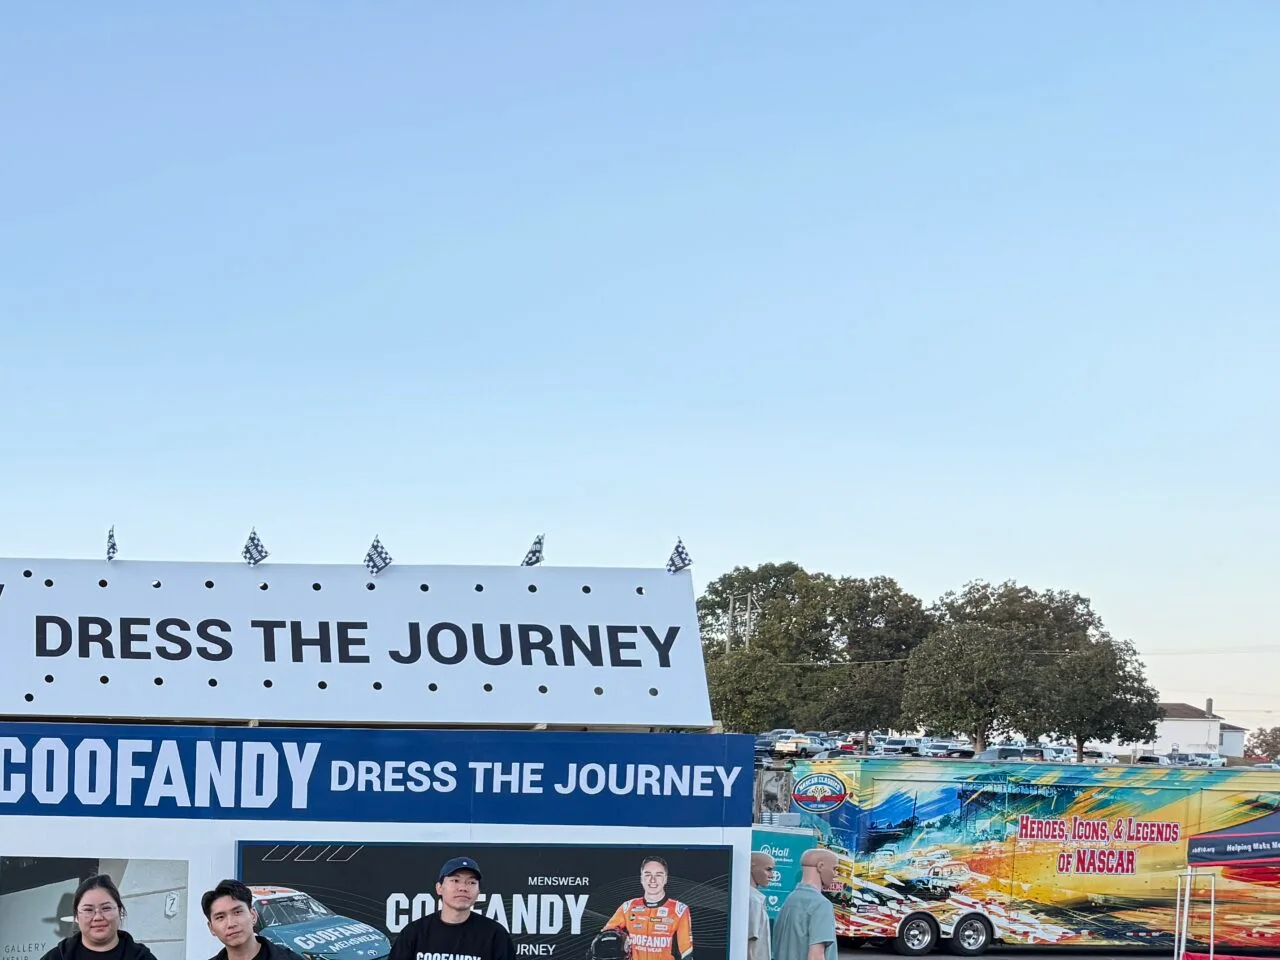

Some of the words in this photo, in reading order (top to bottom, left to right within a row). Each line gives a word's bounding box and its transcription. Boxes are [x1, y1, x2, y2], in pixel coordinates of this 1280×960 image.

[35, 615, 233, 661] DRESS
[251, 620, 369, 664] THE
[388, 621, 681, 668] JOURNEY
[330, 759, 458, 793] DRESS
[469, 762, 544, 794] THE
[554, 763, 741, 797] JOURNEY
[1113, 819, 1122, 840] &
[1126, 818, 1179, 842] LEGENDS
[771, 847, 789, 857] Hall
[1075, 850, 1136, 873] NASCAR
[528, 876, 589, 886] MENSWEAR
[5, 942, 46, 953] GALLERY
